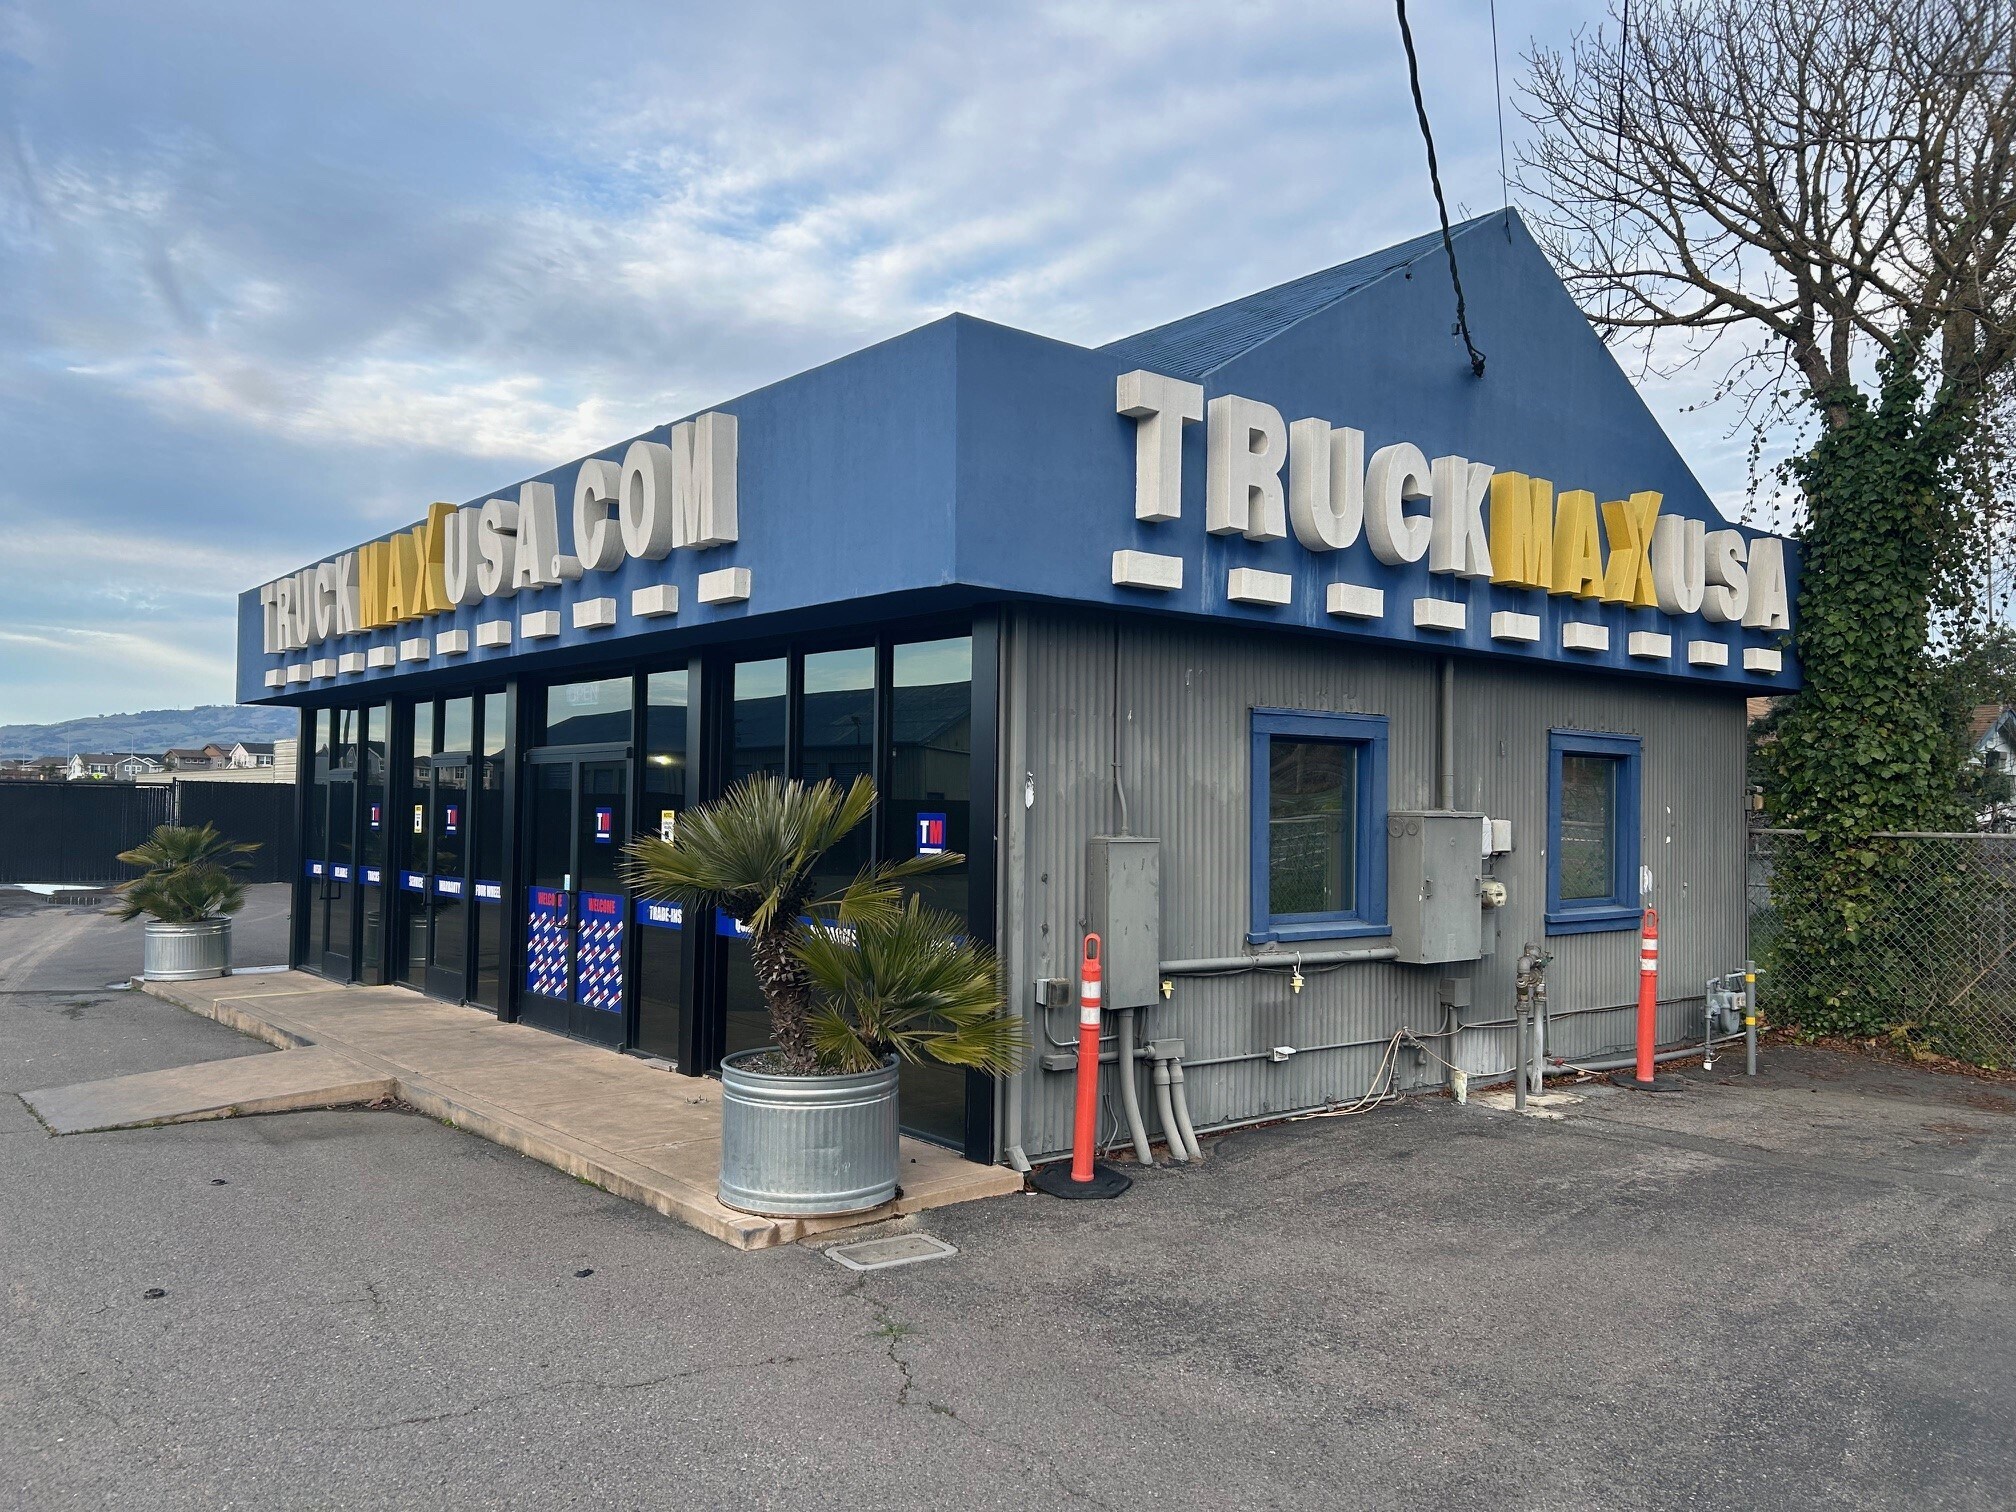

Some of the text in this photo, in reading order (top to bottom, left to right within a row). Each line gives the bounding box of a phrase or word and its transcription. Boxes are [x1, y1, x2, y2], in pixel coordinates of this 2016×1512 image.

[920, 820, 943, 844] TM
[537, 891, 563, 908] WELCOE
[588, 897, 616, 914] WELCOME
[649, 905, 683, 924] TRADE-INS
